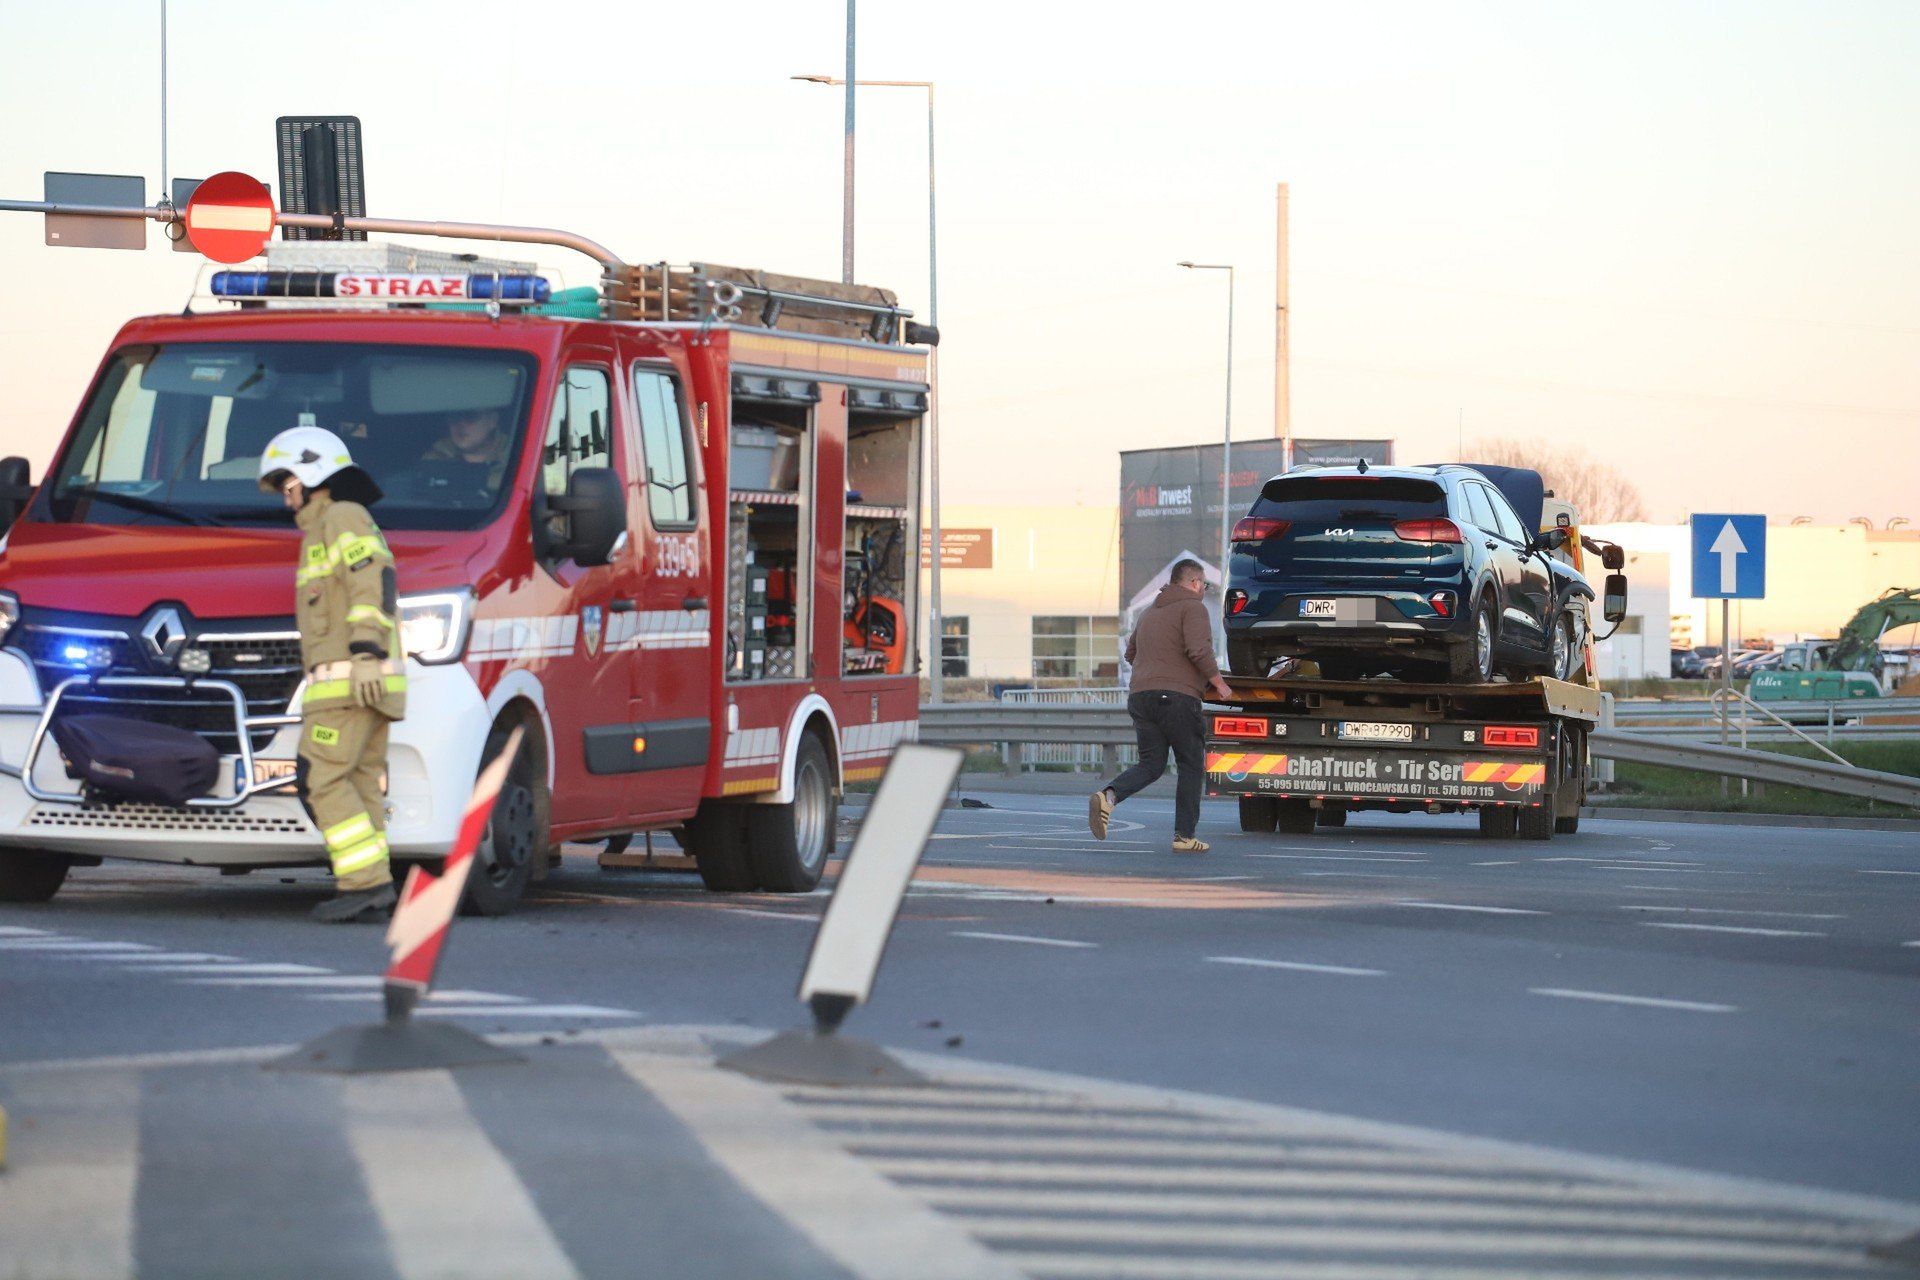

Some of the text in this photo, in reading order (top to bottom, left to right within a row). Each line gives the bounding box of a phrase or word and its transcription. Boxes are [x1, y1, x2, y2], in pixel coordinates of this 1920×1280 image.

[1306, 601, 1330, 614] DWR
[1287, 756, 1463, 781] chaTruck Tir Ser
[1258, 778, 1292, 789] 55-095
[1294, 779, 1327, 791] BYKÓW
[1345, 781, 1409, 794] WROCŁAWSKA
[1411, 784, 1422, 795] 67
[1442, 785, 1459, 796] 576
[1461, 786, 1477, 797] 087
[1479, 787, 1495, 797] 115
